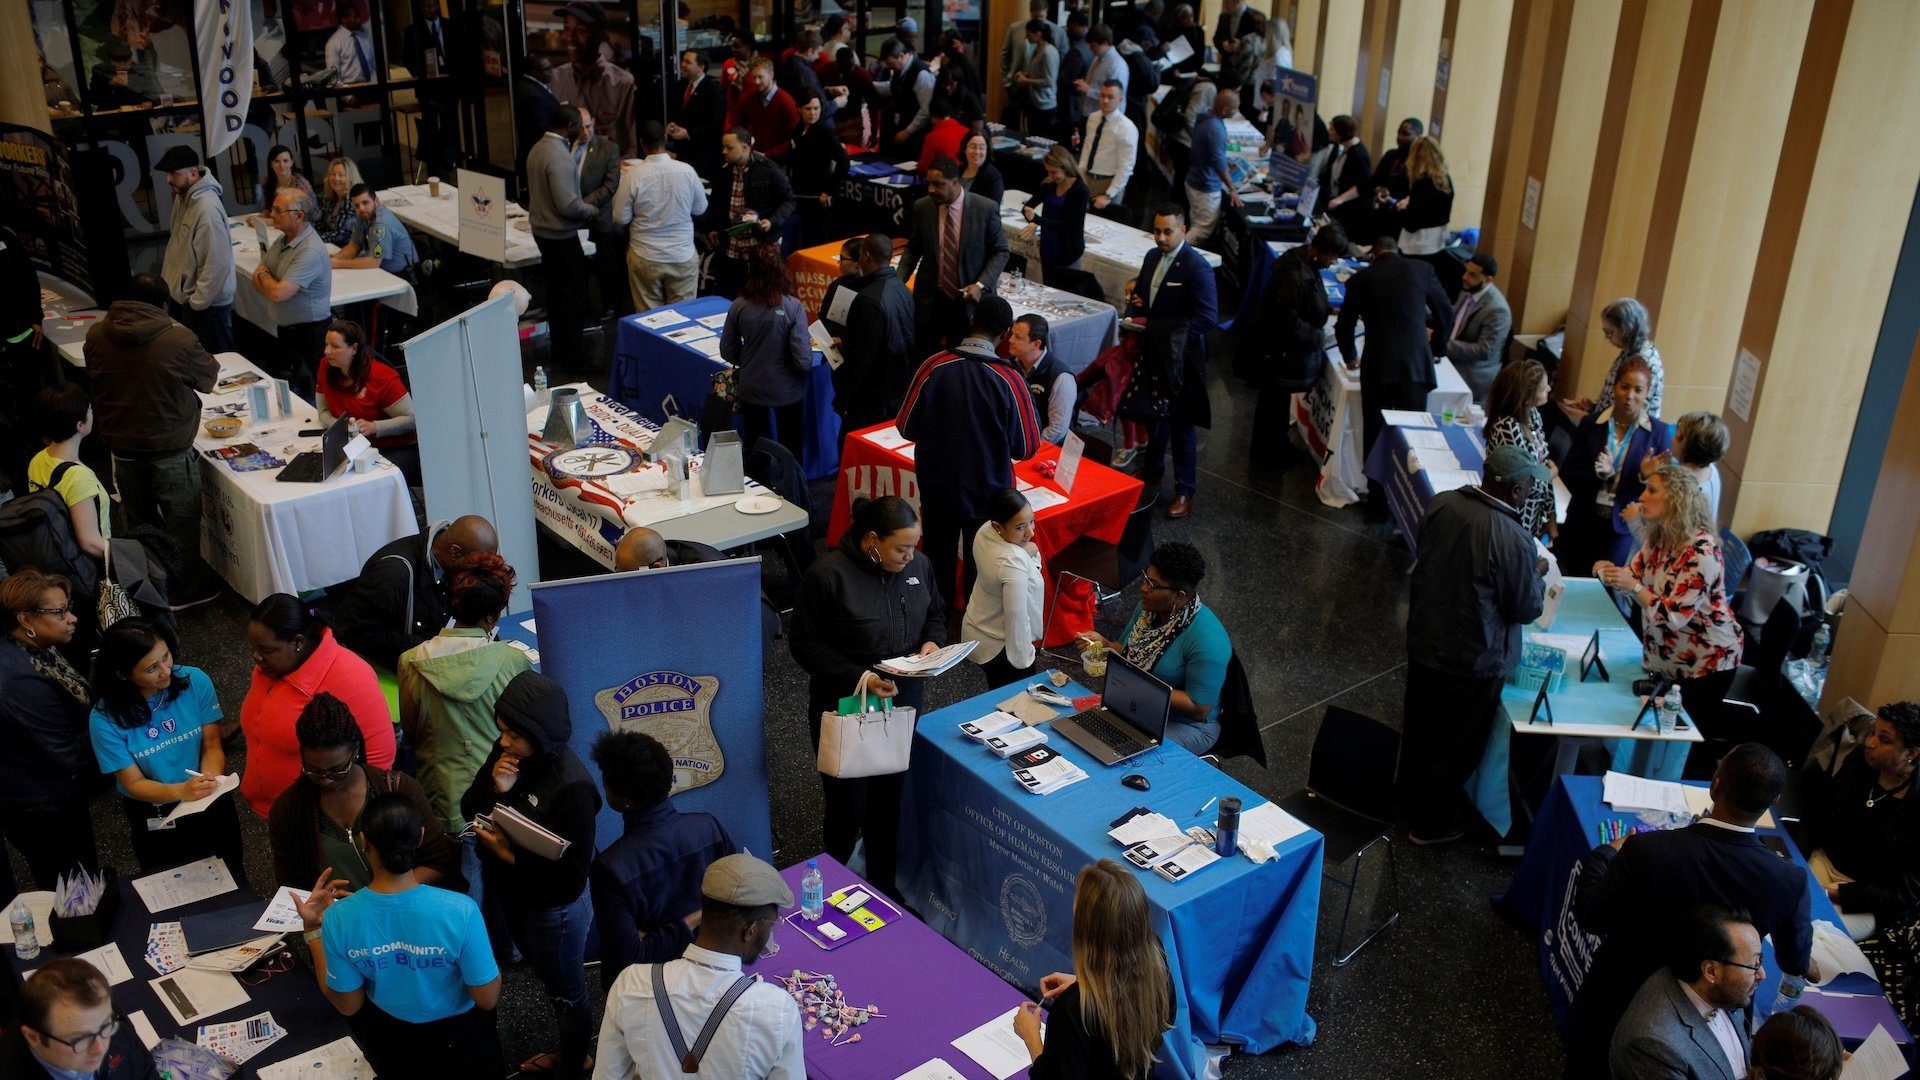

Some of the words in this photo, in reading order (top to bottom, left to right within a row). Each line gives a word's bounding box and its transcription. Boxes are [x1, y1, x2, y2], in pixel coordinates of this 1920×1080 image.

[0, 140, 46, 166] ORKERS
[531, 477, 564, 506] orkers
[617, 673, 700, 700] BOSTON
[623, 699, 694, 718] POLICE
[675, 759, 710, 771] NATION
[965, 806, 994, 831] OFFICE
[995, 825, 1006, 838] OF
[1008, 833, 1040, 860] HUMAN
[1041, 854, 1078, 885] RESOUR
[992, 806, 1012, 826] CITY
[1013, 820, 1026, 833] OF
[1027, 829, 1063, 859] BOSTON
[988, 838, 1010, 857] Mayor
[1011, 852, 1034, 872] Martin
[1043, 873, 1064, 893] Walsh
[348, 947, 371, 959] ONE
[998, 945, 1030, 975] HEALTHY
